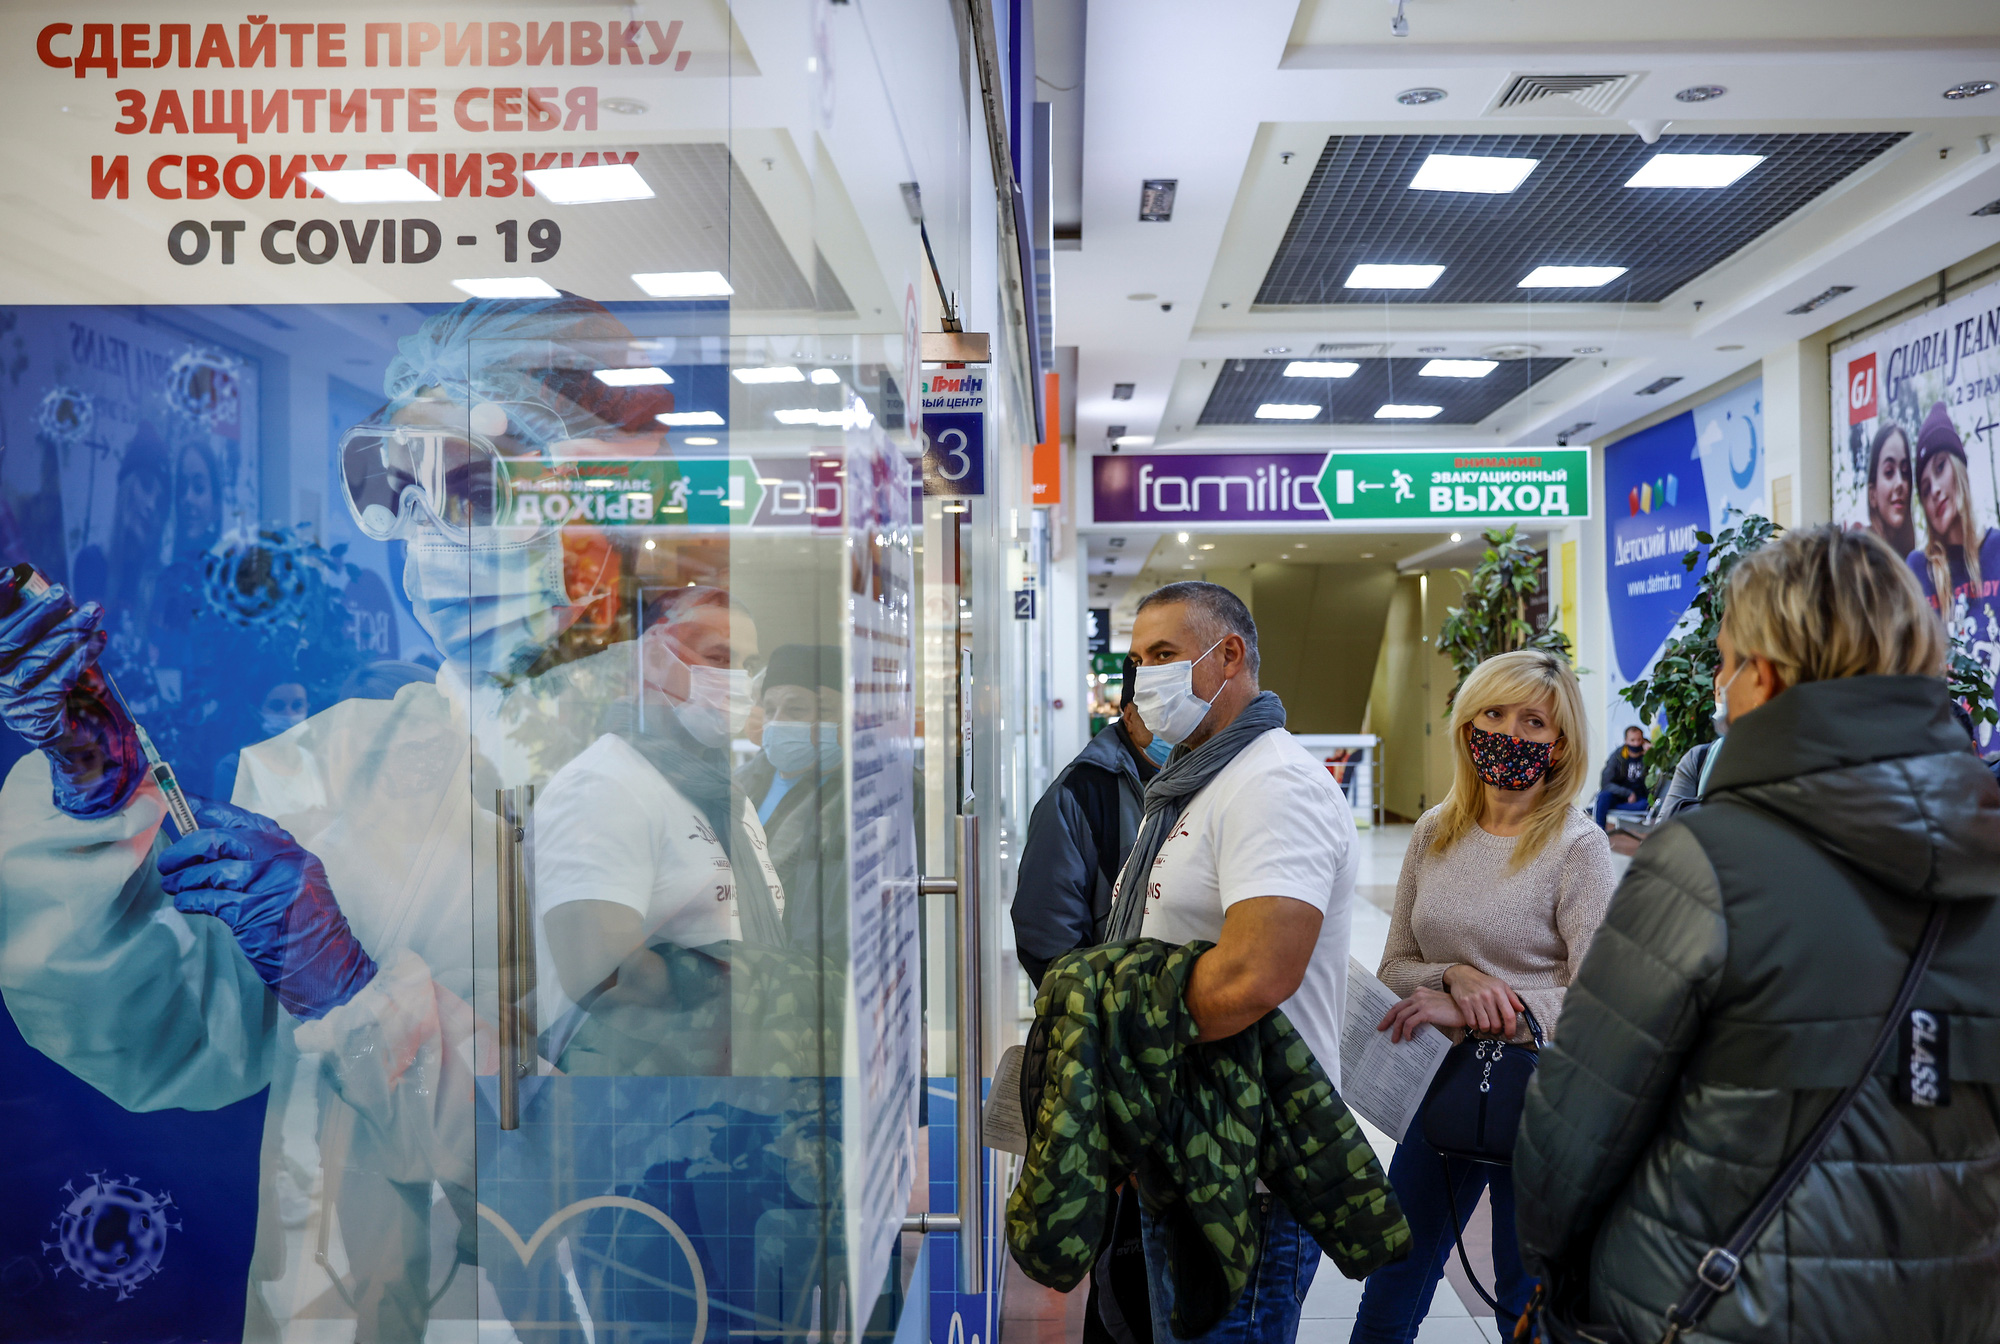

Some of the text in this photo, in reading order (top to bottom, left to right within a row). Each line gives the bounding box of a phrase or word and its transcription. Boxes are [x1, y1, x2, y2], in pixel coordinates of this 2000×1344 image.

[36, 15, 692, 78] СДЕЛАЙТЕ ПРИВИВКУ,
[115, 86, 598, 144] ЗАЩИТИТЕ СЕБЯ
[91, 155, 128, 200] И
[167, 219, 245, 265] ОТ
[259, 219, 442, 265] COVID
[496, 219, 562, 264] 19
[1886, 306, 2000, 404] GLORIA JEAN
[947, 398, 983, 409] ЦЕНТР
[1850, 368, 1874, 410] GJ
[1956, 387, 1963, 405] 2
[1431, 468, 1567, 484] ЭВАКУАЦИОННЫЙ
[1454, 457, 1542, 468] ВНИМАНИЕ!
[1429, 485, 1569, 516] ВЫХОД
[1614, 523, 1698, 566] Детский мир
